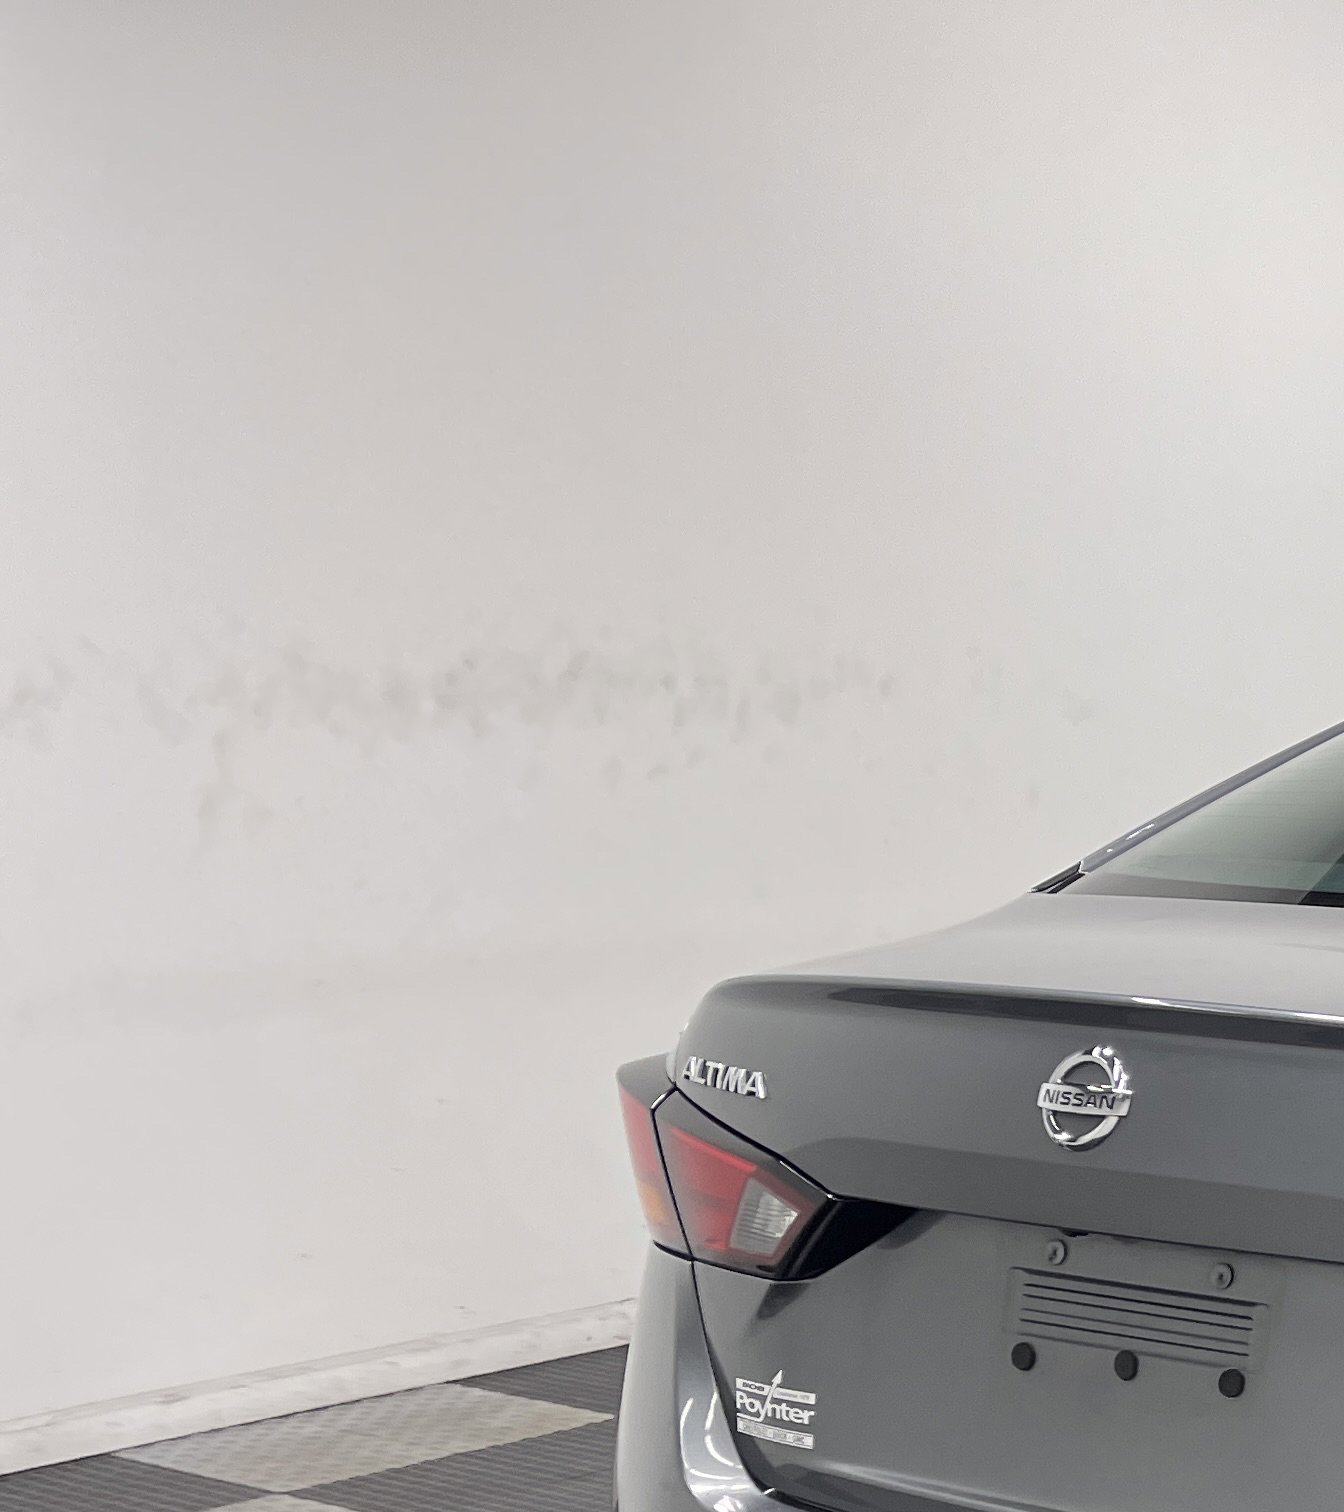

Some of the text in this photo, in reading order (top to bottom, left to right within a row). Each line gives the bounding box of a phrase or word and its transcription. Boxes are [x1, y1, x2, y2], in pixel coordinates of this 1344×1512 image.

[682, 1055, 767, 1099] ALTIMA
[1043, 1088, 1116, 1110] NISSAN
[735, 1390, 815, 1424] Poynter
